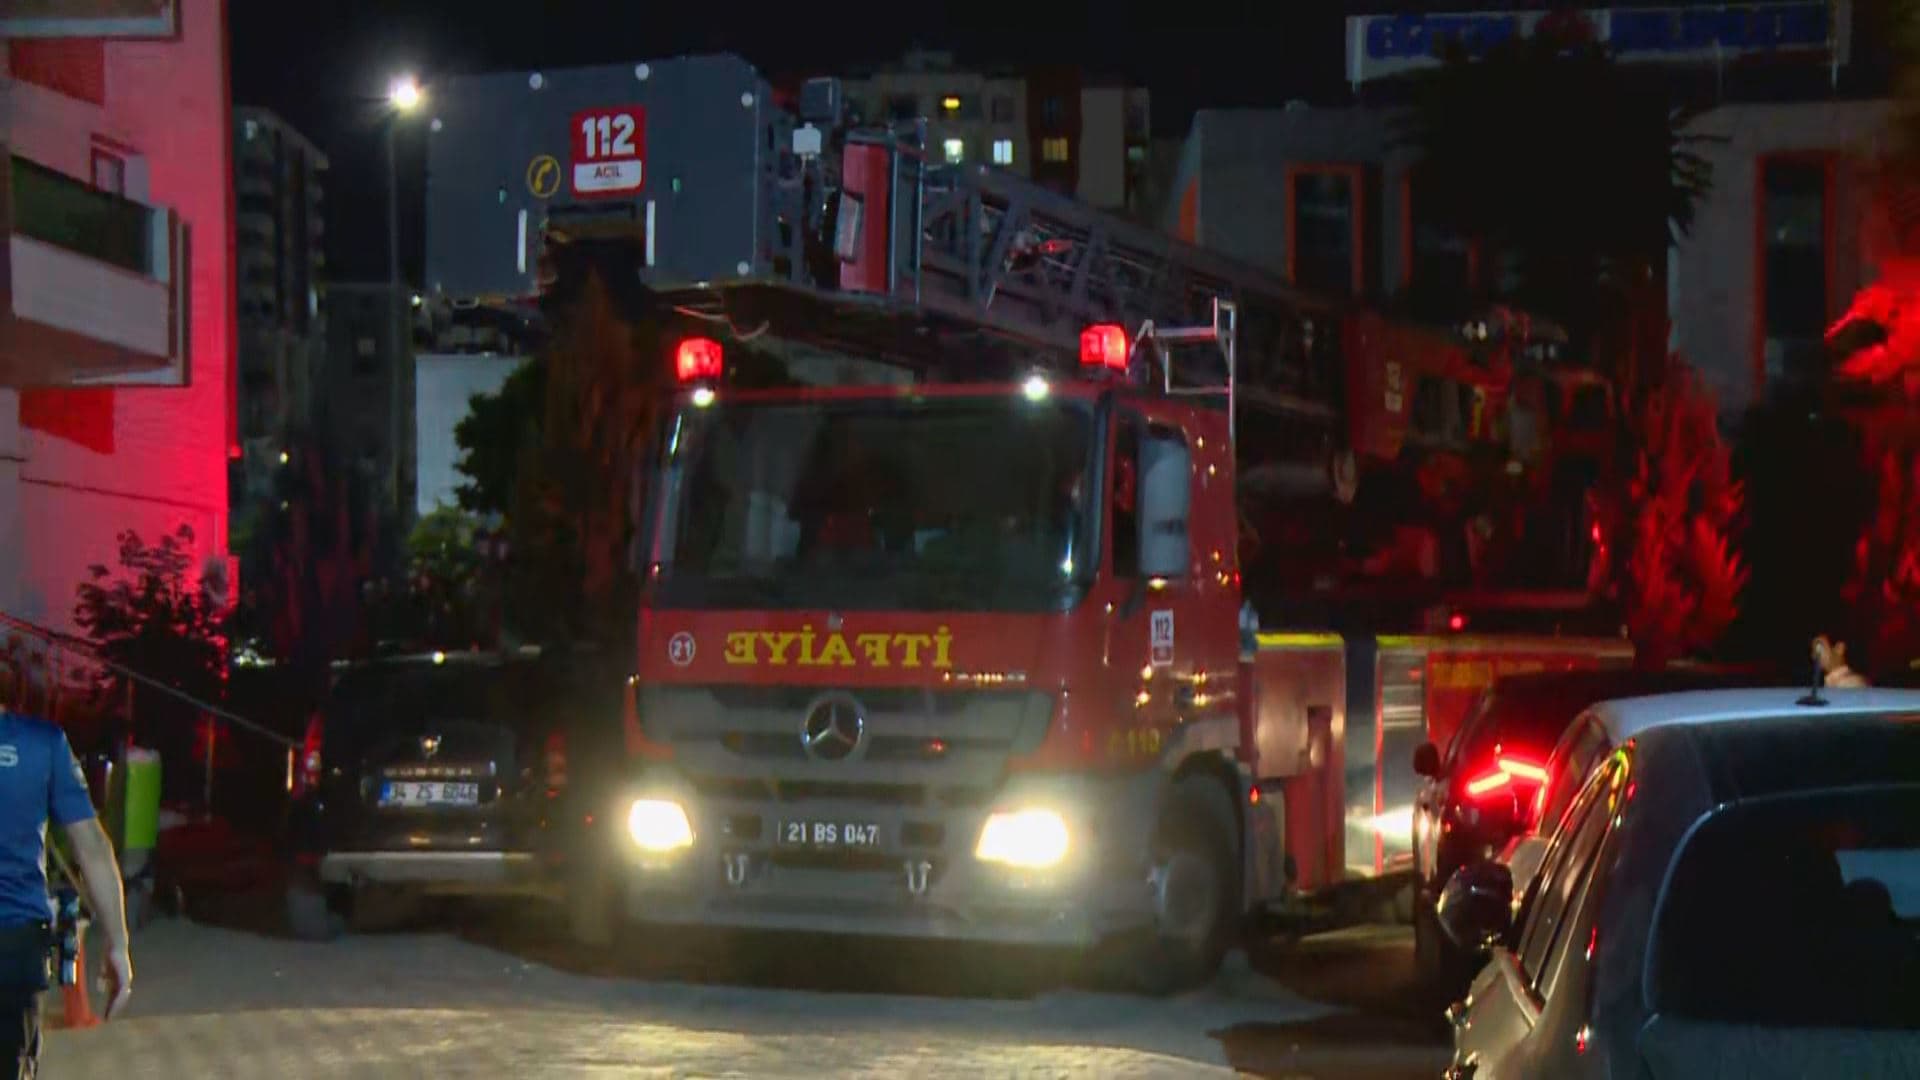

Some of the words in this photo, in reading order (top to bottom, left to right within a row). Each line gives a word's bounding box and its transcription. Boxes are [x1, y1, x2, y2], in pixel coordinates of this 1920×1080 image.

[582, 113, 635, 158] 112
[1155, 618, 1170, 640] 112
[673, 640, 691, 657] 21
[788, 822, 807, 843] 21
[814, 822, 838, 844] BS
[844, 823, 878, 846] 047
